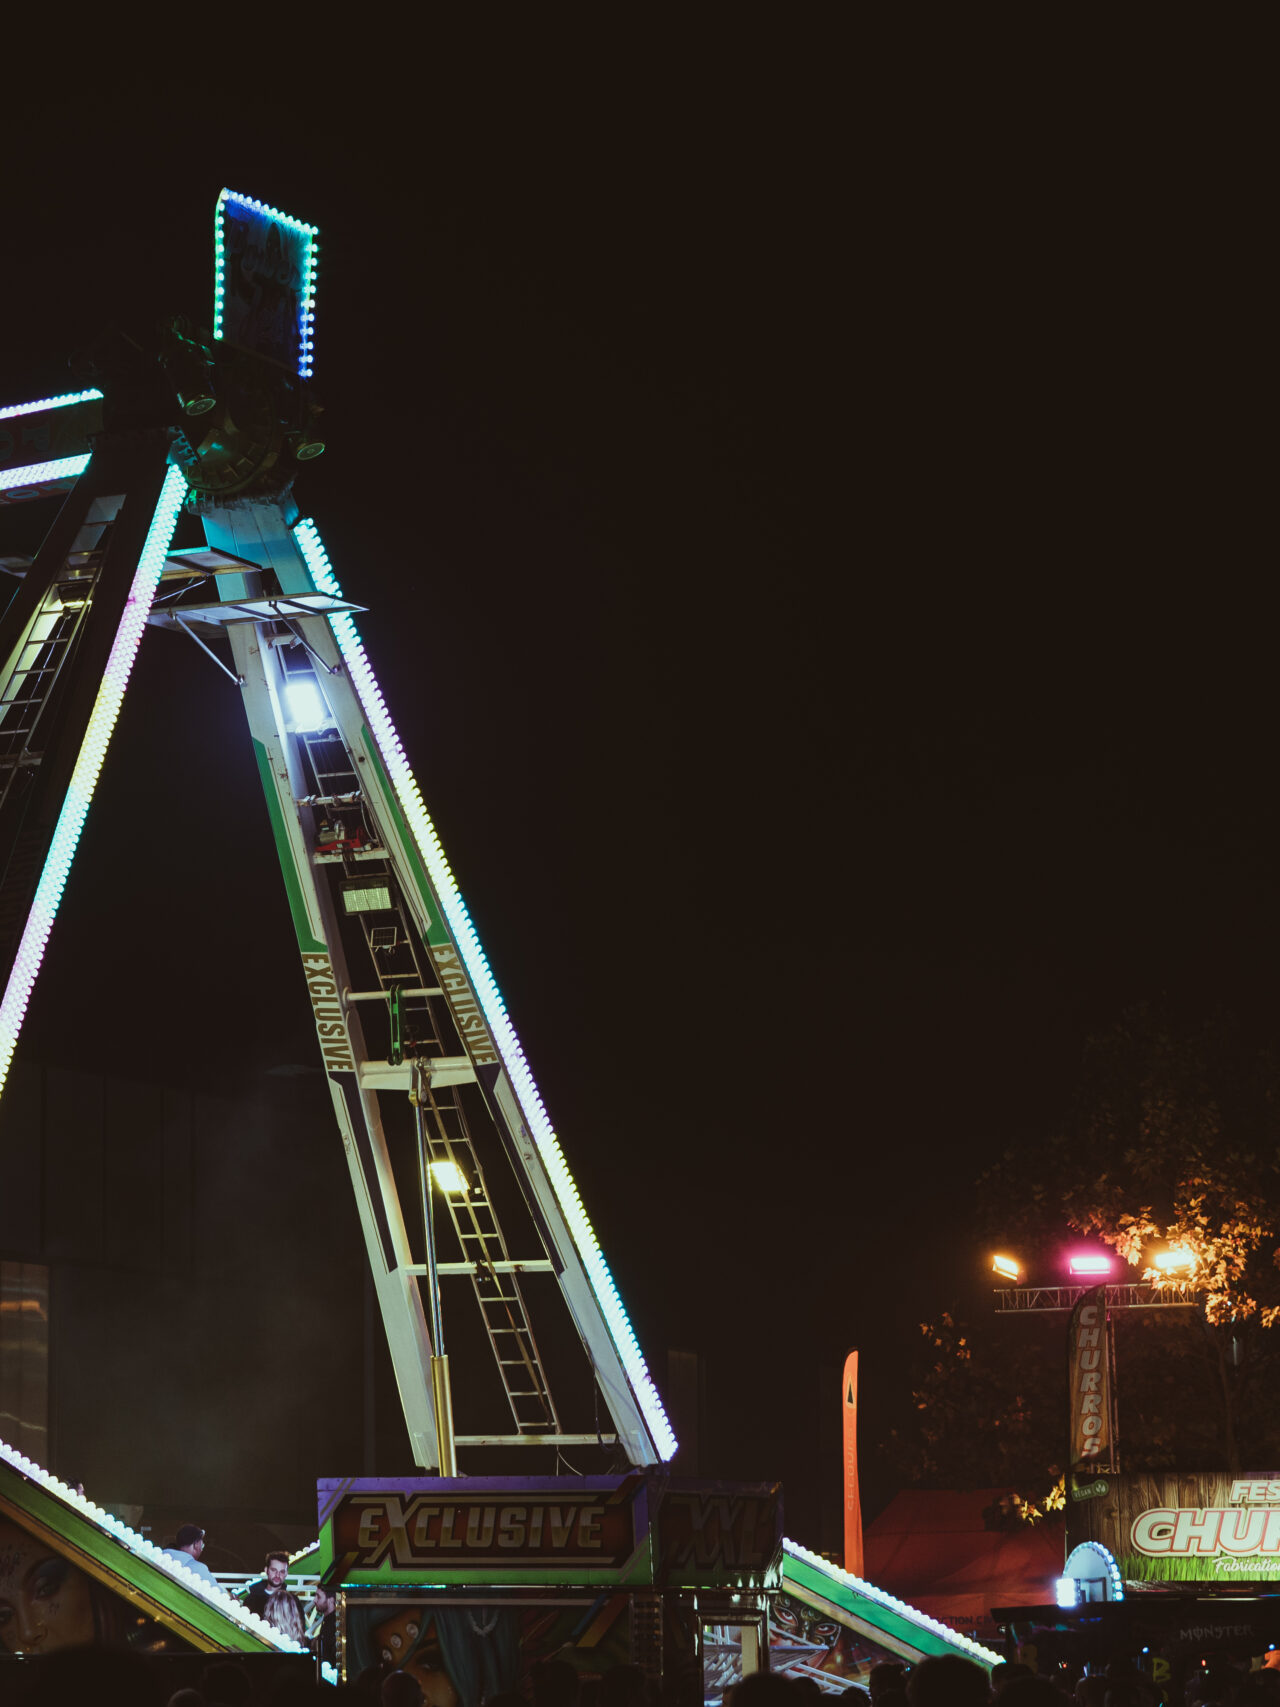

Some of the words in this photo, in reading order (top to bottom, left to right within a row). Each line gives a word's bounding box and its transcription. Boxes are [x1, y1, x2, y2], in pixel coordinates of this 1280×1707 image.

[301, 953, 355, 1072] EXCLUSIVE
[434, 945, 498, 1066] EXCLUSIVE
[1078, 1305, 1102, 1457] CHURROS
[354, 1495, 610, 1565] EXCLUSIVE
